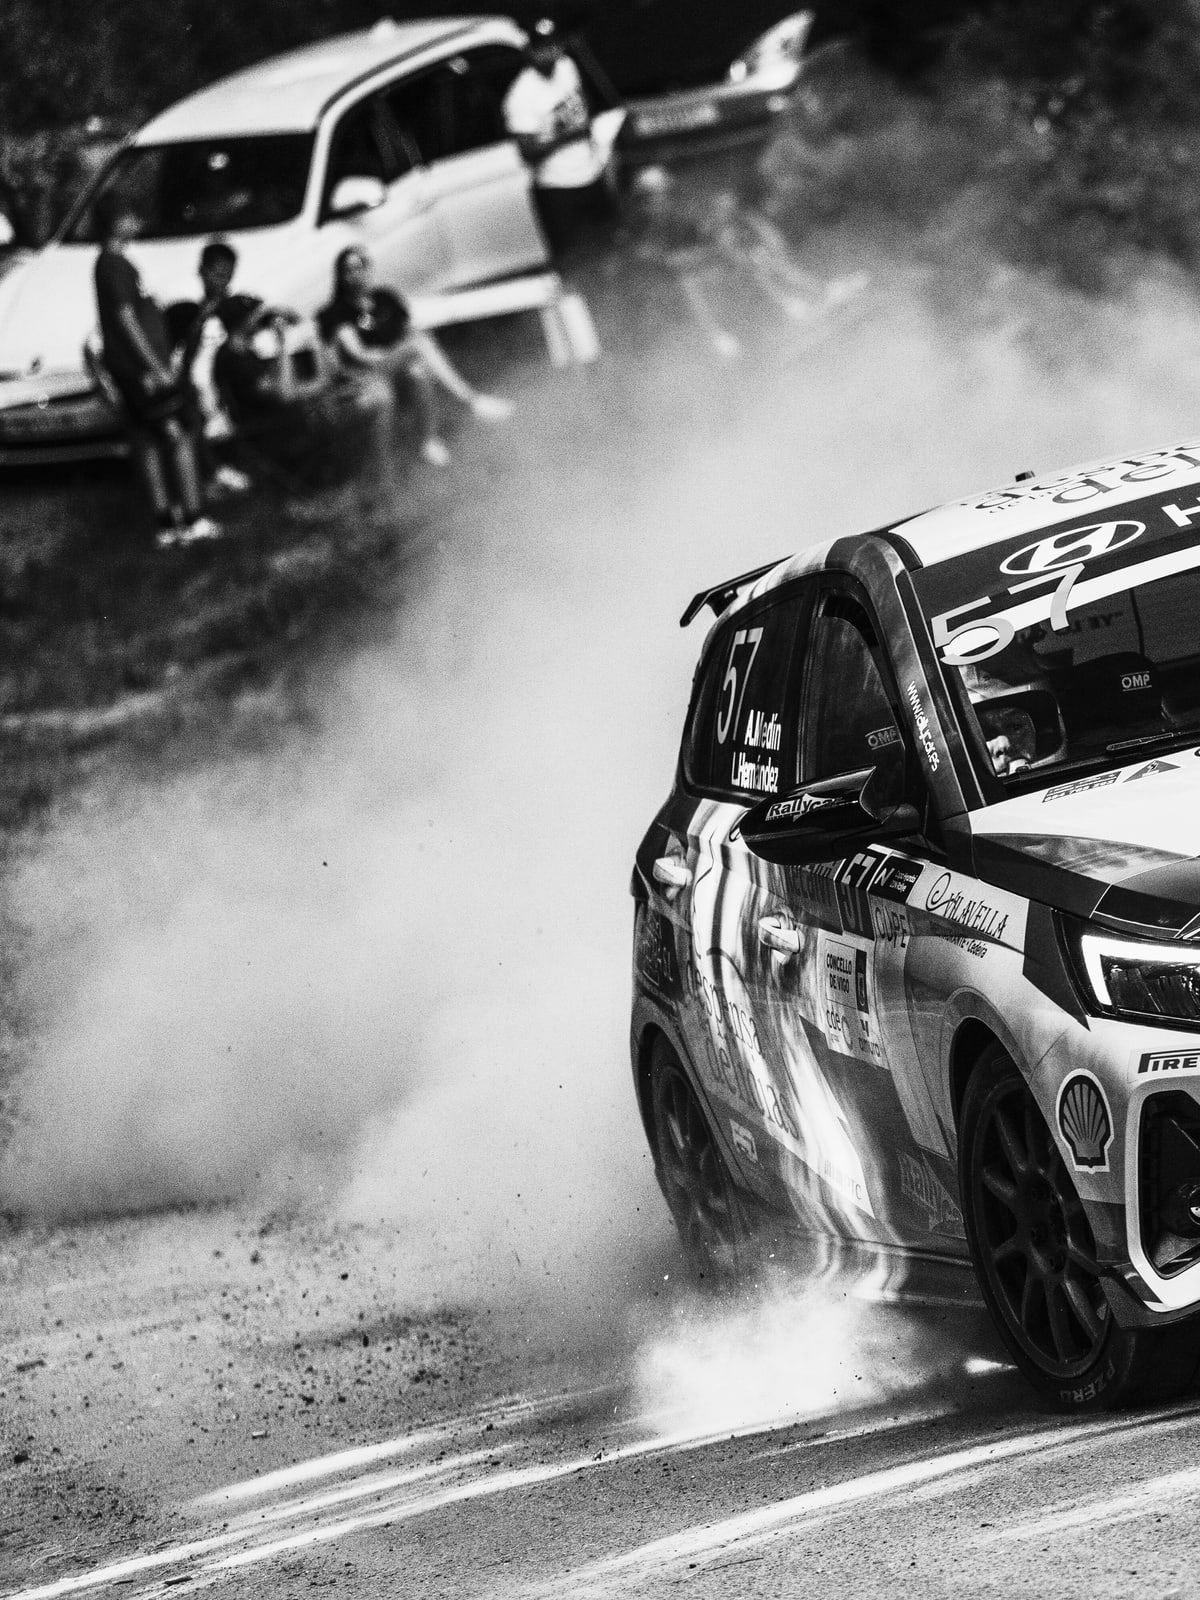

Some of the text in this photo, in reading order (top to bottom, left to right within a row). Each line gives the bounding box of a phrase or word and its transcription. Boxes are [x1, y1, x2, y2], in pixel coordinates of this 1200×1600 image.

[931, 562, 1085, 666] 57
[717, 627, 764, 744] 57
[1121, 673, 1151, 691] OMP
[826, 953, 853, 975] CONCELLO
